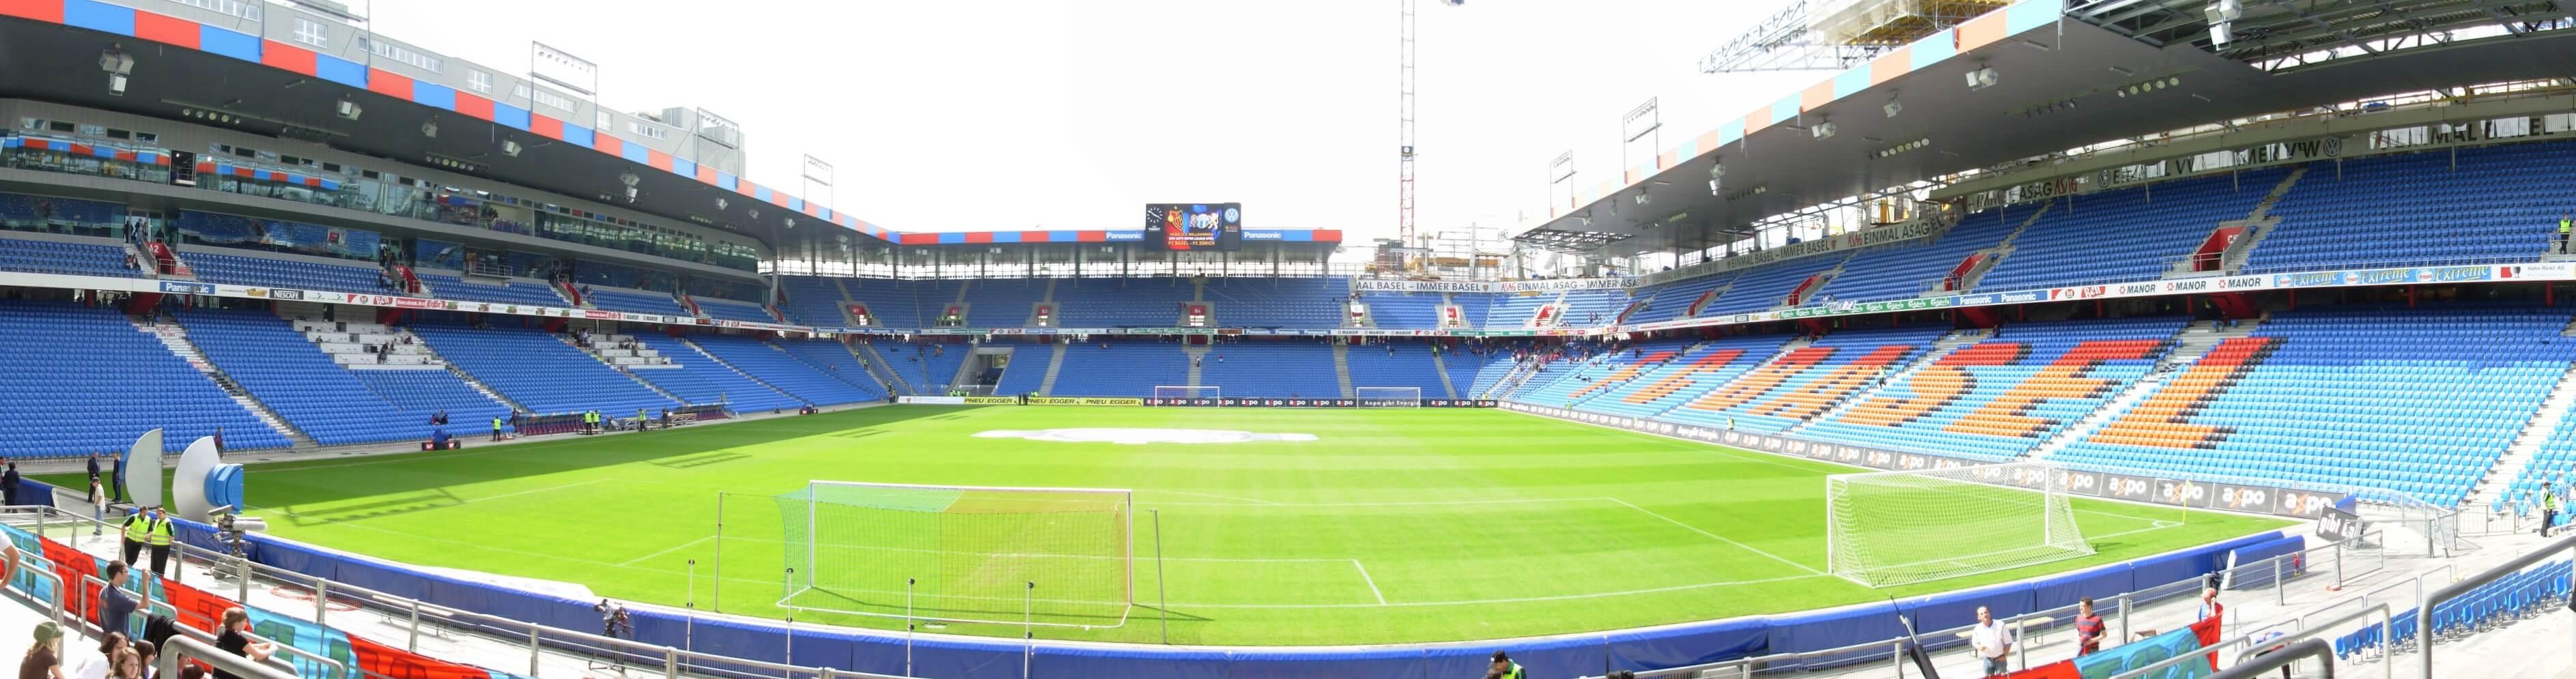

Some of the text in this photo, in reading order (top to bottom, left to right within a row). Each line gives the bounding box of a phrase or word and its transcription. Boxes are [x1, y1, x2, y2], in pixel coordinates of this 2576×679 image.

[1106, 231, 1142, 240] Panasonic
[1864, 227, 1899, 244] EINMAL
[1901, 222, 1930, 238] ASAG
[1731, 255, 1754, 268] EINMAL
[1755, 250, 1774, 263] BASEL
[1781, 244, 1804, 259] IMMER
[1807, 240, 1830, 255] BASEL
[166, 283, 210, 294] Panasic
[1377, 281, 1407, 290] BASEL
[1416, 282, 1449, 291] IMMER
[1452, 283, 1480, 291] BASEL
[1517, 282, 1551, 291] EINMAL
[1553, 280, 1577, 290] ASAG
[1587, 279, 1617, 289] IMMER
[2175, 280, 2206, 291] MANOR
[2228, 278, 2261, 287] MANOR
[2127, 284, 2155, 294] MANOR
[2001, 291, 2036, 303] Panasonic
[1383, 399, 1395, 407] gibt
[2109, 476, 2147, 496] axpo
[2163, 481, 2205, 503] axpo
[2222, 487, 2265, 508] axpo
[2318, 512, 2341, 535] gibt
